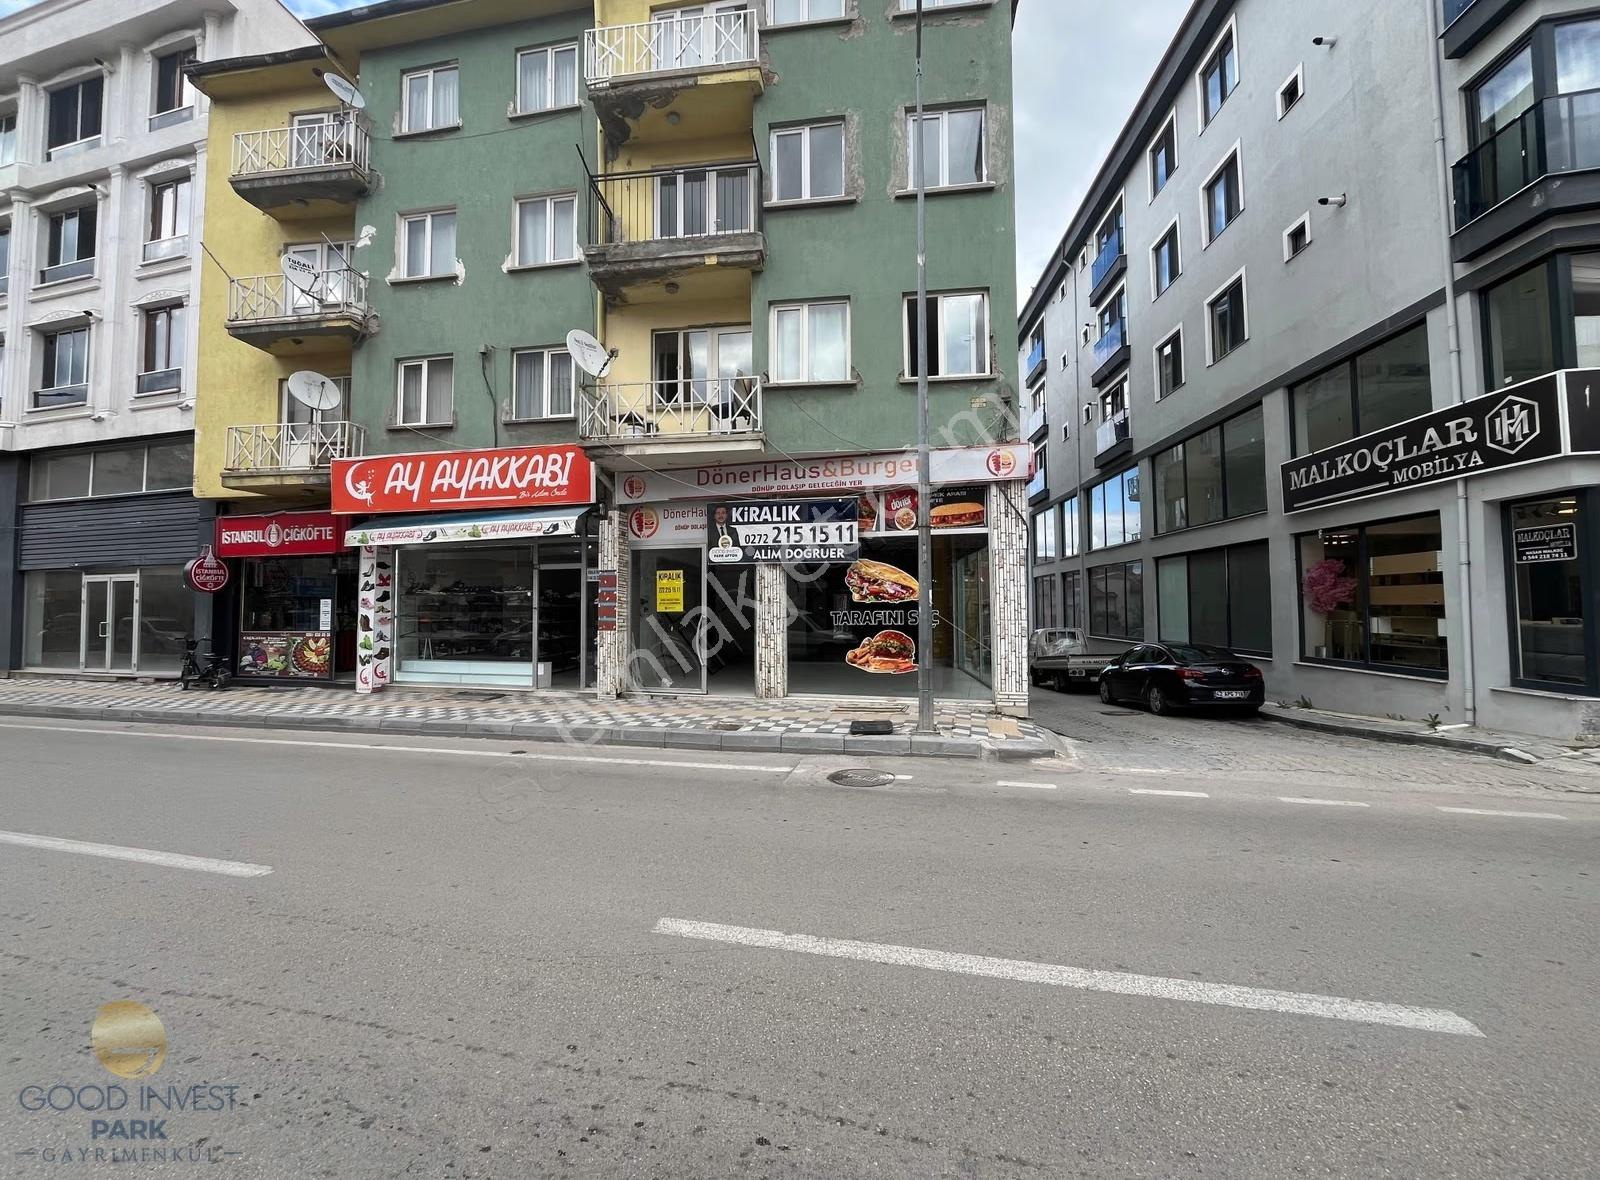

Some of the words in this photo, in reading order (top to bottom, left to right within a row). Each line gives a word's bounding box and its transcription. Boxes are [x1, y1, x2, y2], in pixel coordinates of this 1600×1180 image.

[1289, 416, 1478, 491] MALKOÇLAR
[384, 461, 425, 503] AY
[430, 452, 575, 500] AYAKKABI
[1393, 450, 1485, 486] MOBİLYA
[751, 484, 775, 492] DÖNÜP
[776, 483, 806, 492] DOLAŞIP
[808, 481, 846, 489] GELECEĞİN
[221, 528, 266, 545] İSTANBUL
[283, 525, 333, 545] ÇİĞKÖFTE
[744, 533, 769, 545] 0272
[772, 526, 803, 544] 215
[809, 525, 829, 543] 15
[835, 524, 854, 542] 11
[1517, 529, 1570, 543] MALKOÇLAR
[753, 547, 782, 560] ALİM
[786, 545, 845, 560] DOĞRUER
[830, 610, 904, 626] TARAFINI
[908, 609, 940, 629] SÇ
